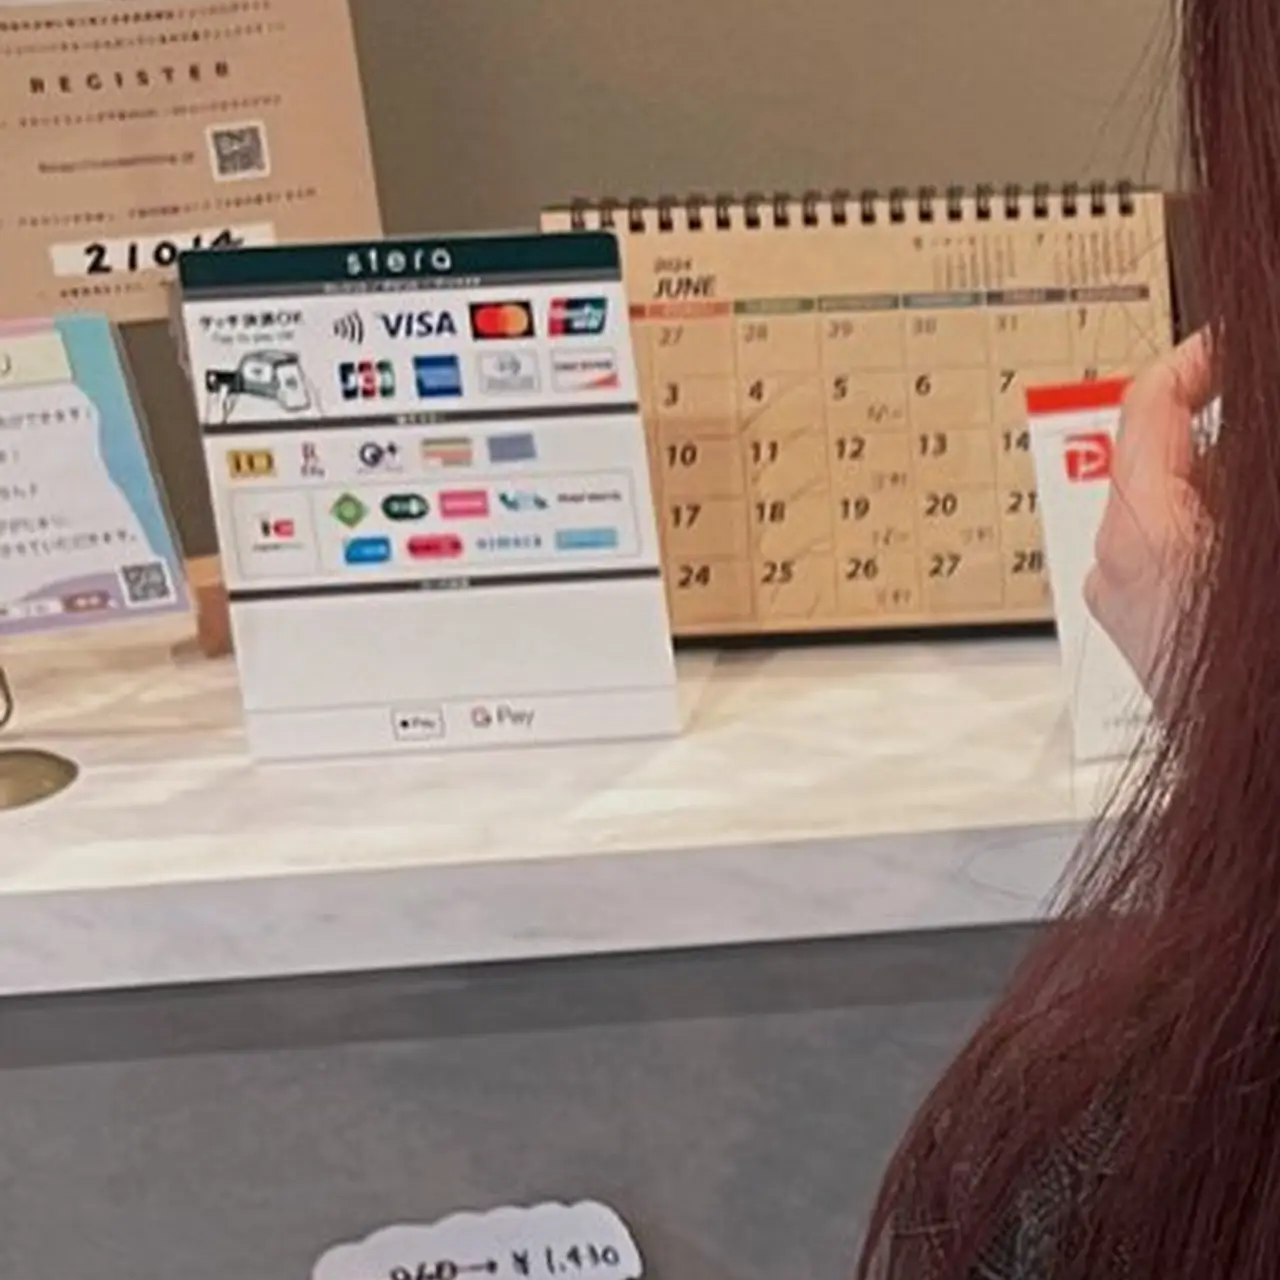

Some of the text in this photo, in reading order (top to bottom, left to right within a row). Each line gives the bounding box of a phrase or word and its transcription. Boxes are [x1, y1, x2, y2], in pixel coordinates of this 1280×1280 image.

[28, 60, 230, 94] REGISTER
[652, 275, 716, 299] JUNE
[381, 311, 457, 338] VISA
[659, 325, 683, 347] 27
[664, 372, 1016, 407] 3 4 5 6 7
[667, 431, 1031, 468] 10 11 12 13 14
[671, 491, 1037, 529] 17 18 19 20 21
[677, 549, 1045, 590] 24 25 26 27 28
